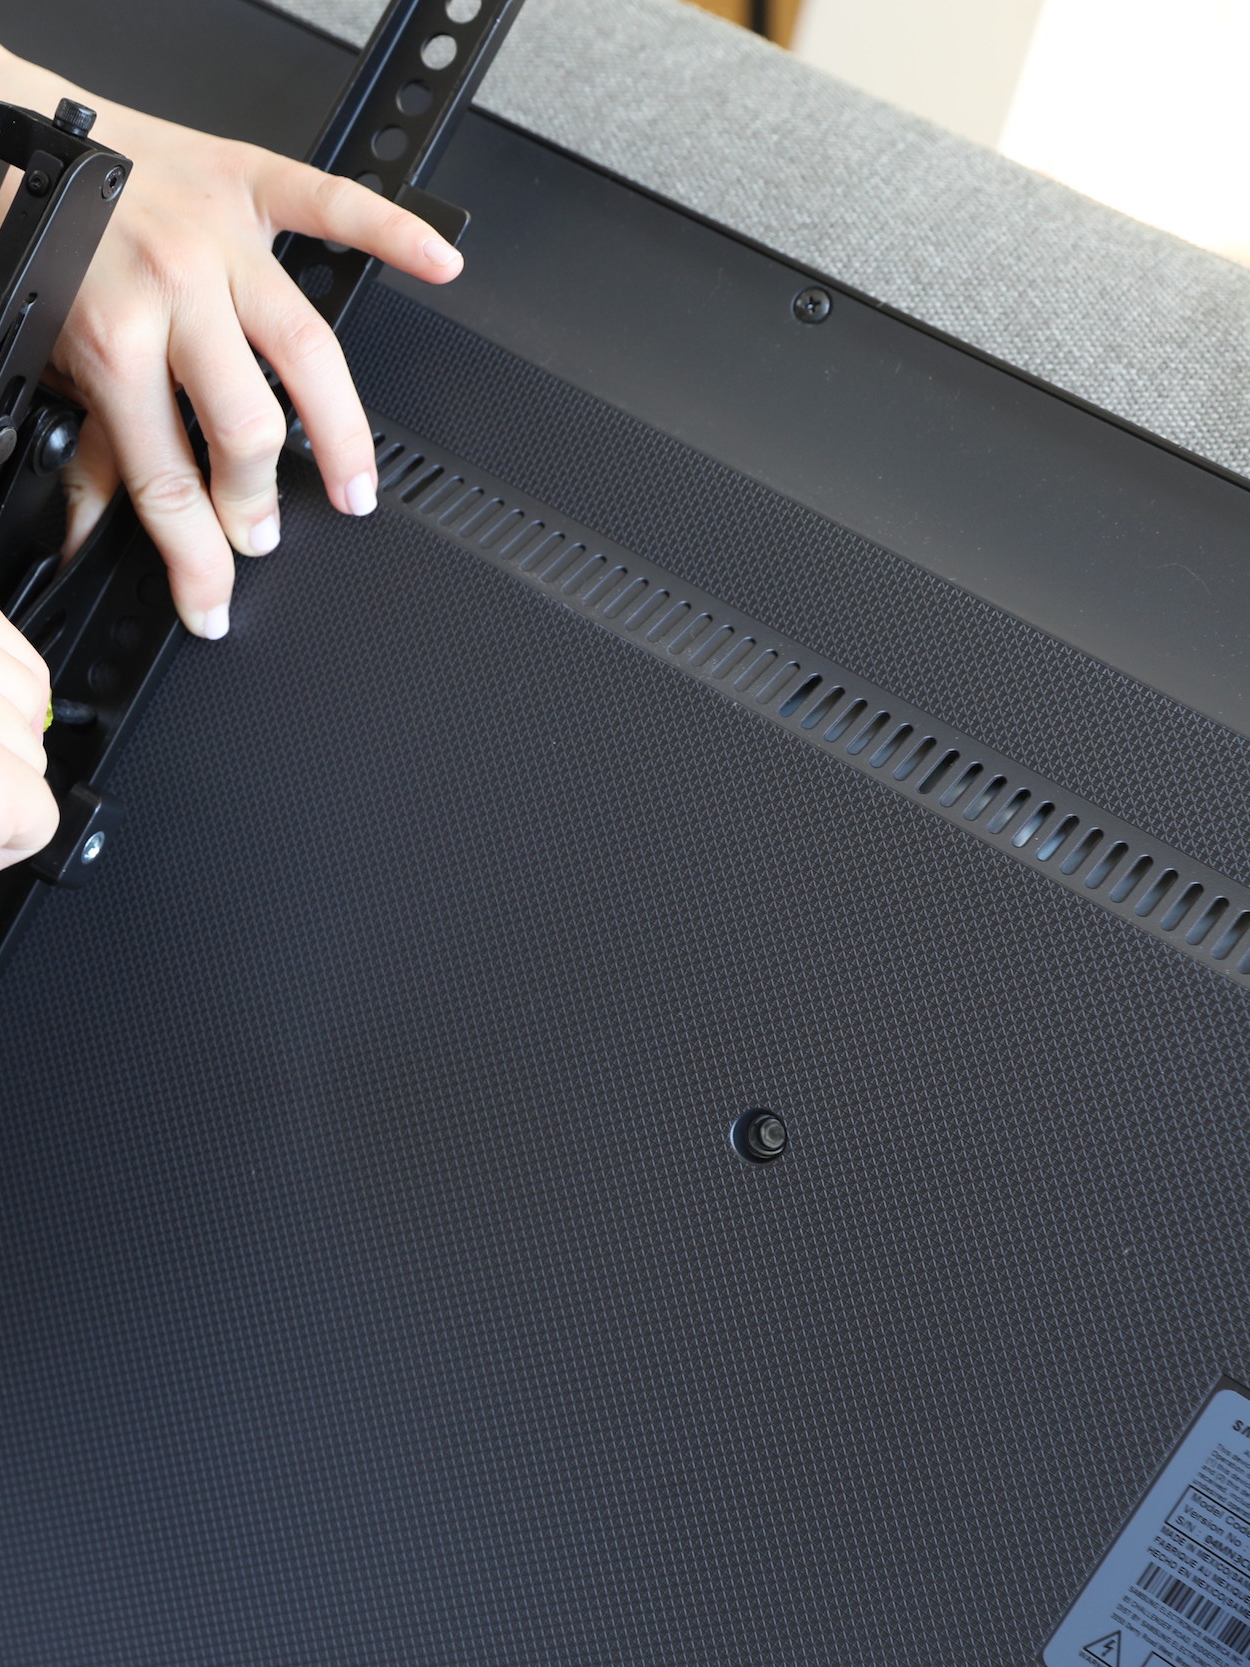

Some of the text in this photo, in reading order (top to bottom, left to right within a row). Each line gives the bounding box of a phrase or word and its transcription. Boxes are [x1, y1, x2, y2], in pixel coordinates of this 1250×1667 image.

[1190, 1492, 1225, 1519] Model
[1160, 1525, 1187, 1547] MADE
[1185, 1542, 1197, 1553] IN
[1174, 1515, 1196, 1533] S/N
[1183, 1503, 1225, 1536] Version
[1225, 1531, 1242, 1547] No
[1147, 1546, 1178, 1569] HECHO
[1176, 1565, 1192, 1579] EN
[1153, 1535, 1198, 1569] FABRIQUE
[1197, 1565, 1211, 1578] AU
[1127, 1585, 1160, 1610] SAMSUNG
[1157, 1605, 1203, 1639] ELECTRONICS
[1201, 1635, 1231, 1658] AMERICA
[1130, 1600, 1173, 1631] CHALLENGER
[1139, 1619, 1172, 1644] SAMSUNG
